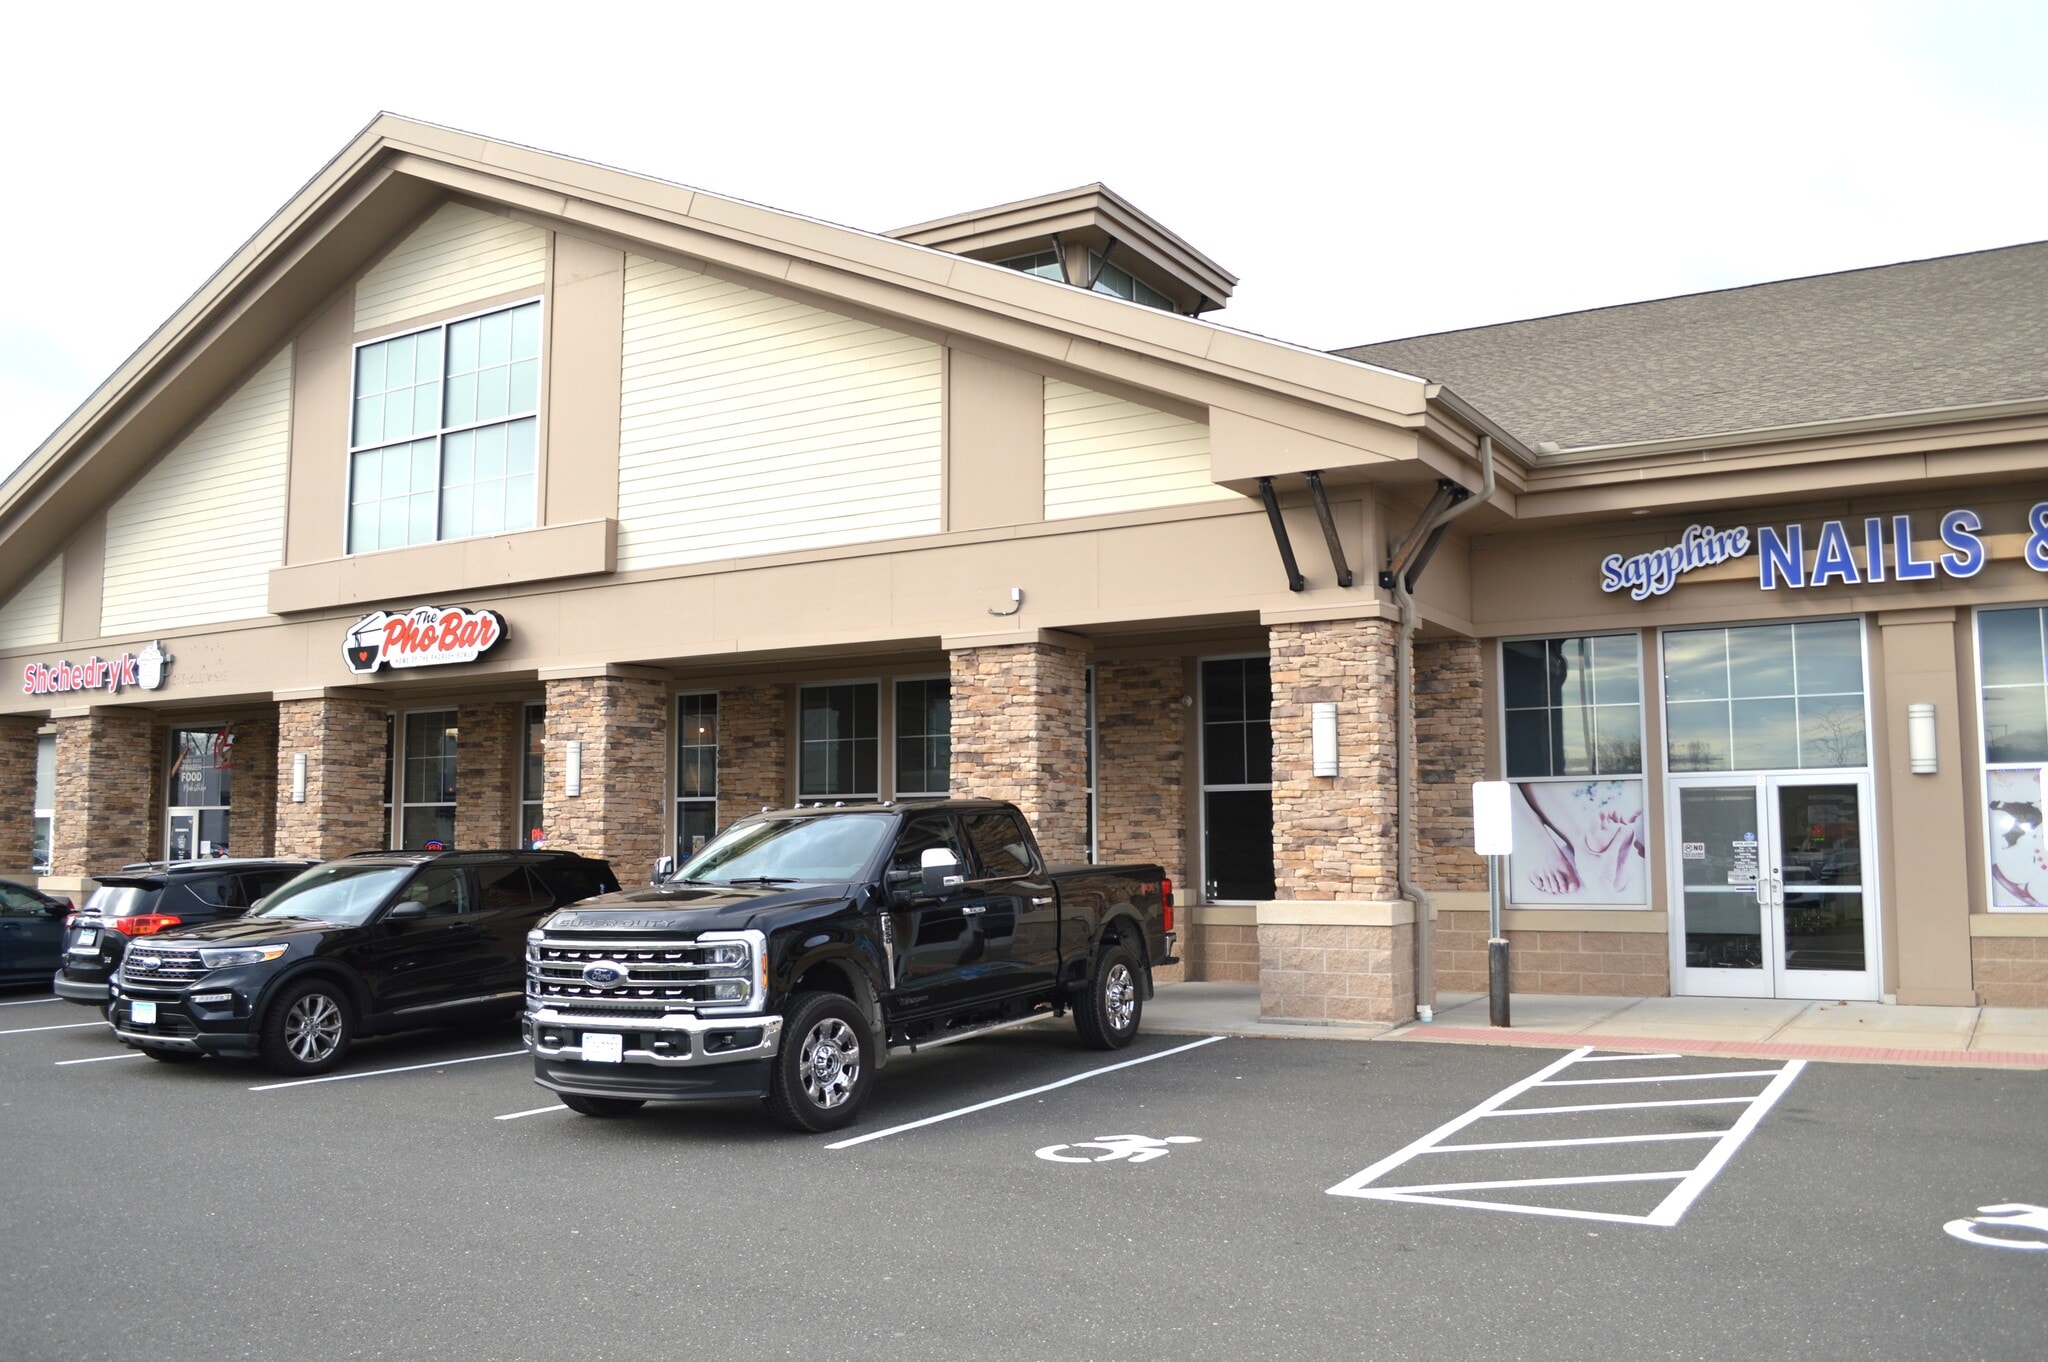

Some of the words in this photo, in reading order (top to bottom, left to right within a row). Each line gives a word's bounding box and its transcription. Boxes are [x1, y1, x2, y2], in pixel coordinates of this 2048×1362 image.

[1601, 524, 1751, 601] Sapphire
[1758, 509, 1985, 591] NAILS
[415, 610, 438, 625] The
[23, 652, 137, 695] Shchedryk
[180, 772, 202, 782] FOOD
[560, 919, 617, 928] SUPER
[620, 919, 676, 928] DUTY
[591, 967, 613, 981] Ford
